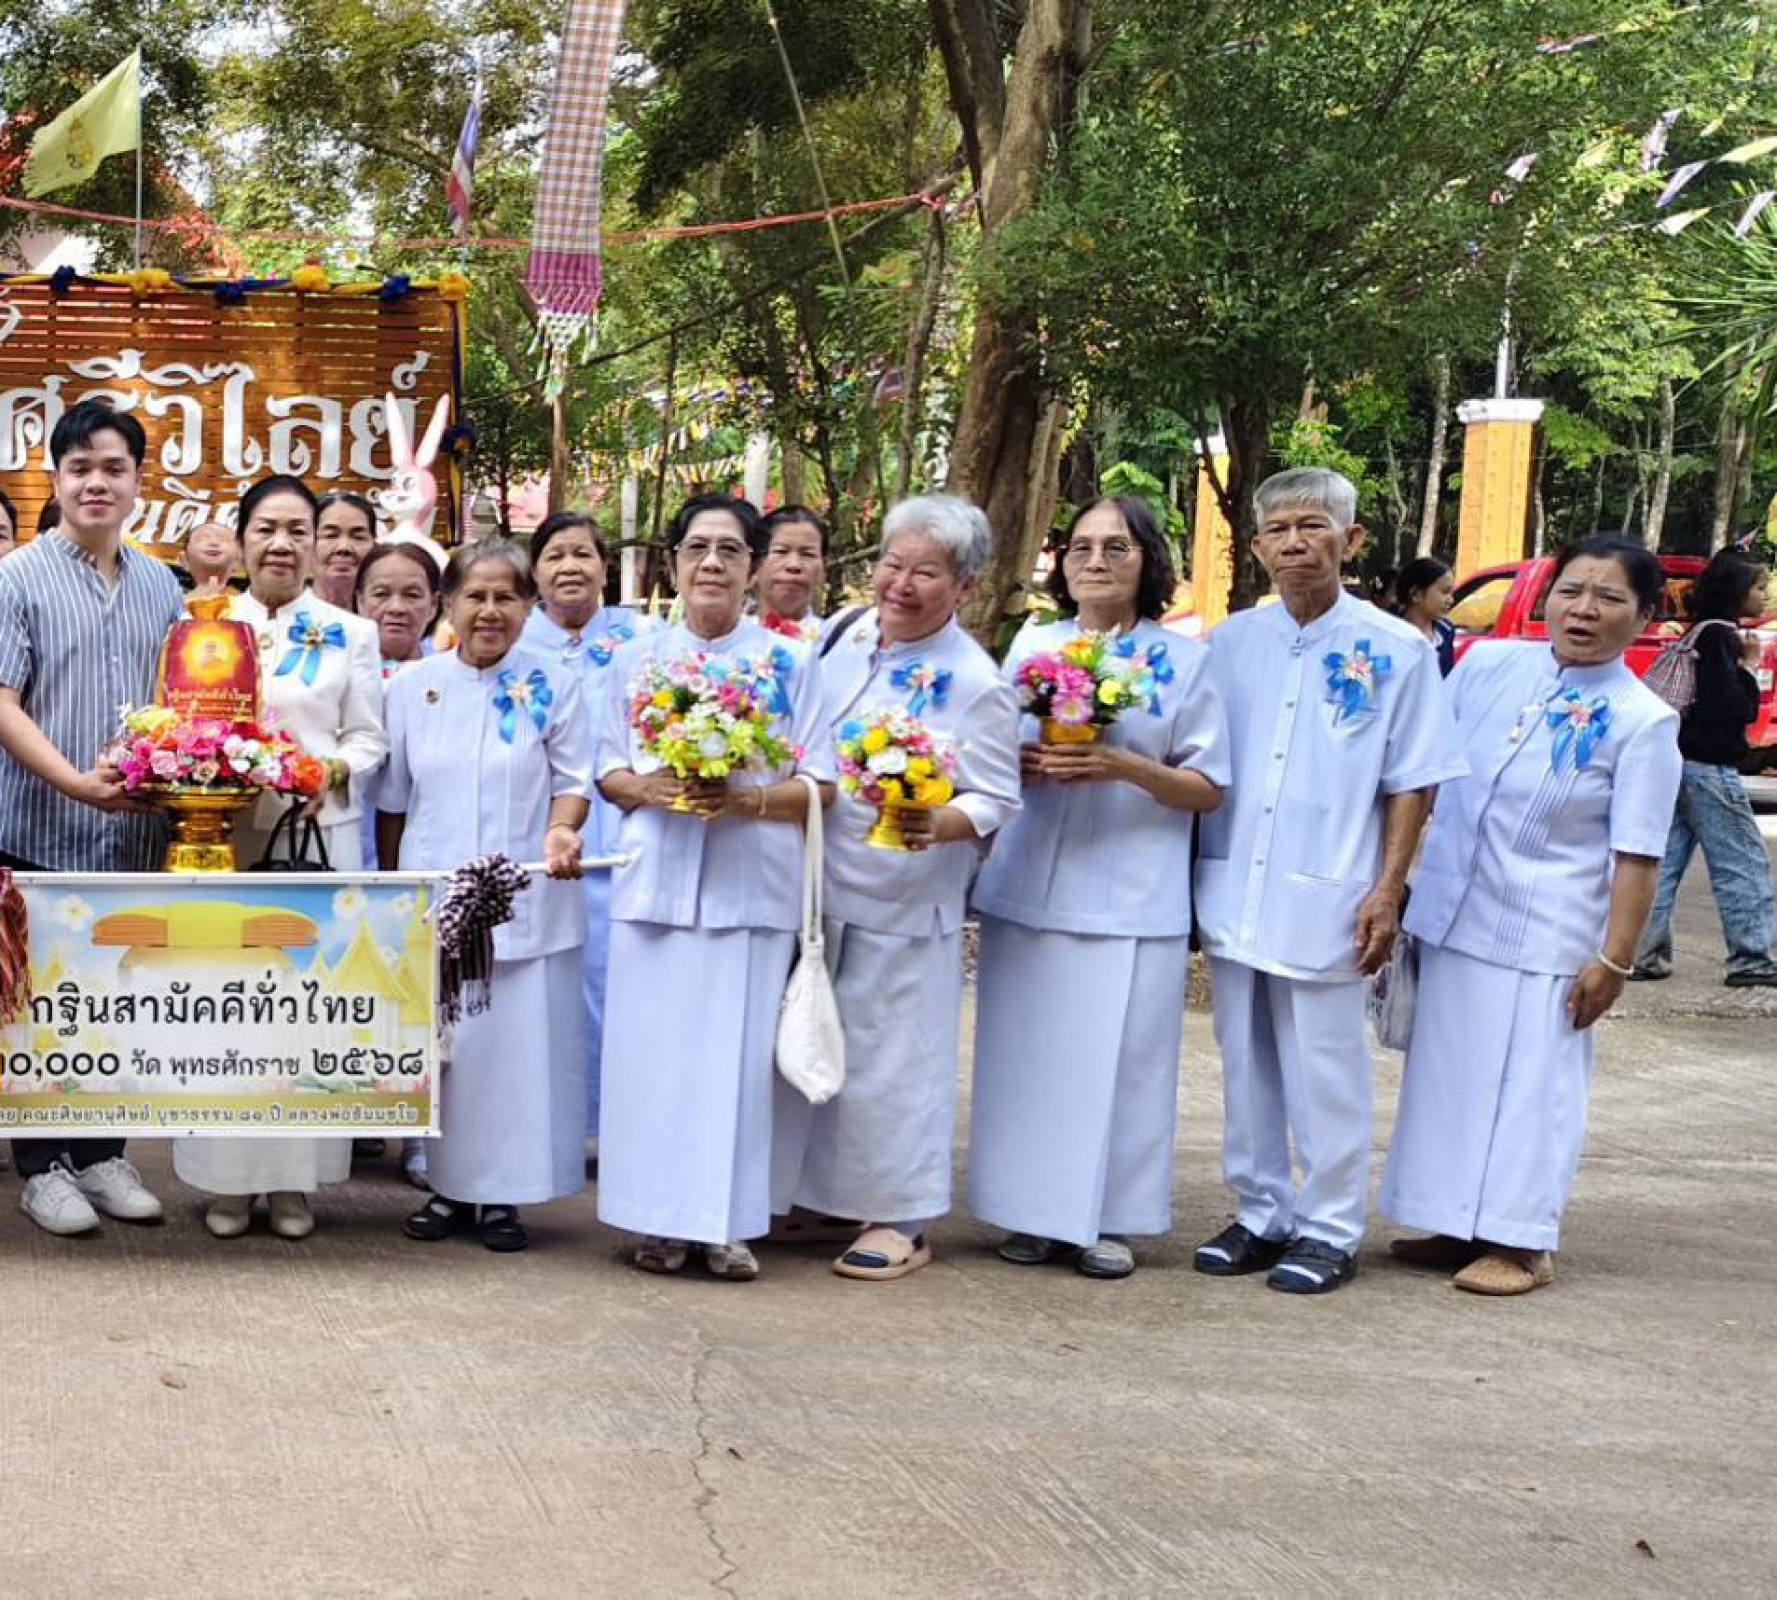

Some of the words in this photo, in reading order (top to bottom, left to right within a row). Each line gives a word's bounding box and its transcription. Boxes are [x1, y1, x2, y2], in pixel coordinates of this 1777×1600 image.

[29, 970, 374, 1036] กฐินสามัคคีทั่วไทย
[131, 1048, 161, 1075] วัด
[169, 1049, 300, 1085] พุทธศักราช
[311, 1048, 423, 1076] ๒๕๖๘
